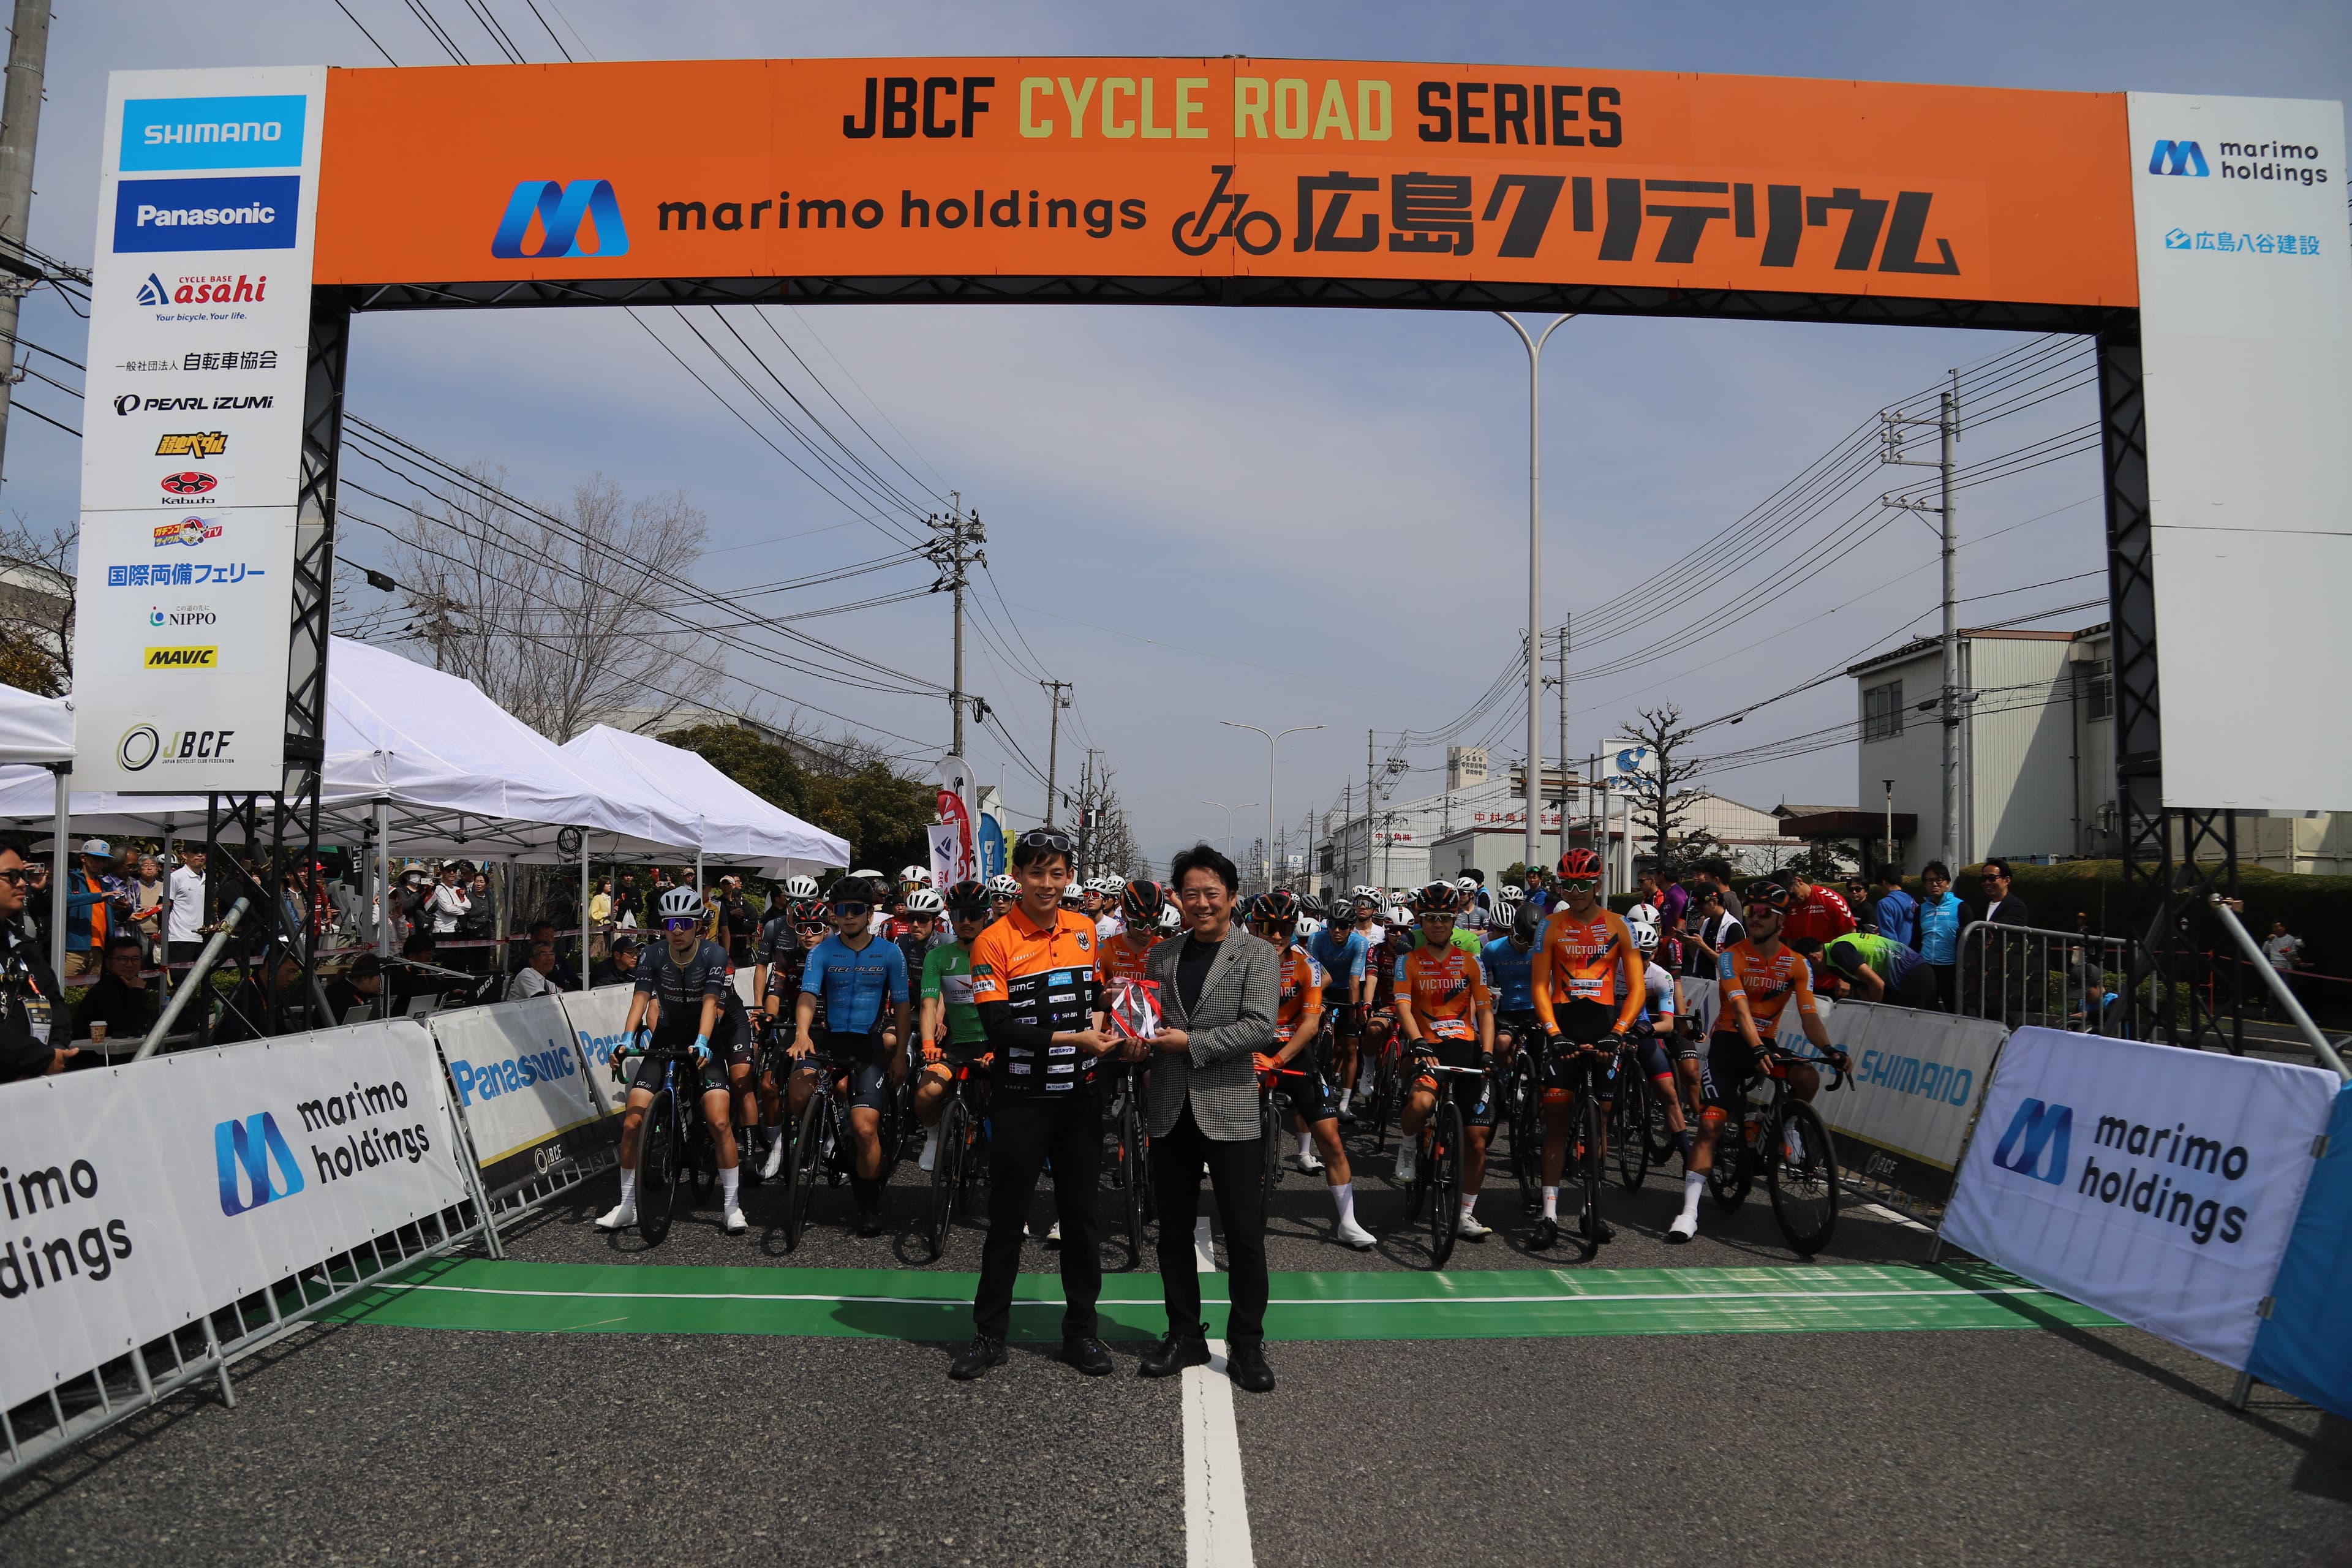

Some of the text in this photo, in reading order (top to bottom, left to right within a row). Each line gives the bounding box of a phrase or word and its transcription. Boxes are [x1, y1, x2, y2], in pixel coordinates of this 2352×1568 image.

[843, 77, 1623, 149] JBCF CYCLE ROAD SERIES
[144, 121, 282, 145] SHIMANO
[2219, 140, 2319, 160] marimo
[2221, 160, 2328, 186] holdings
[137, 202, 276, 227] Panasonic
[657, 189, 1147, 238] marimo holdings
[1293, 170, 1962, 276] 広島クリテリウム
[2195, 231, 2320, 256] 広島八谷建設
[174, 274, 267, 304] asahi
[156, 313, 174, 322] Your
[176, 312, 208, 322] bicycle.
[230, 311, 247, 320] life.
[115, 350, 278, 372] 一般社団法人 自転車協会
[144, 397, 209, 411] PEARL
[155, 431, 228, 459] 弱虫ペダル
[154, 525, 180, 537] ガチンコ
[155, 534, 181, 546] サイクル
[208, 527, 221, 537] TV
[108, 563, 265, 586] 国際両備フェリー
[169, 612, 216, 625] NIPPO
[148, 649, 214, 665] MAVIC
[162, 731, 235, 758] JBCF
[1087, 809, 1096, 827] 1
[1565, 944, 1608, 955] VICTOIRE
[945, 957, 960, 971] J
[1112, 970, 1146, 980] VICTOI
[476, 974, 494, 999] JBCF
[1009, 981, 1036, 993] BMC
[1419, 978, 1468, 991] VICTOIRE
[1743, 976, 1789, 992] VICTOIRE
[450, 1038, 575, 1107] Panasonic
[1856, 1049, 1973, 1107] SHIMANO
[297, 1080, 408, 1132] marimo
[311, 1123, 431, 1184] holdings
[545, 1144, 562, 1164] JBCF
[2094, 1114, 2248, 1182] marimo
[0, 1159, 98, 1220] imo
[2078, 1157, 2247, 1245] holdings
[0, 1219, 132, 1299] dings
